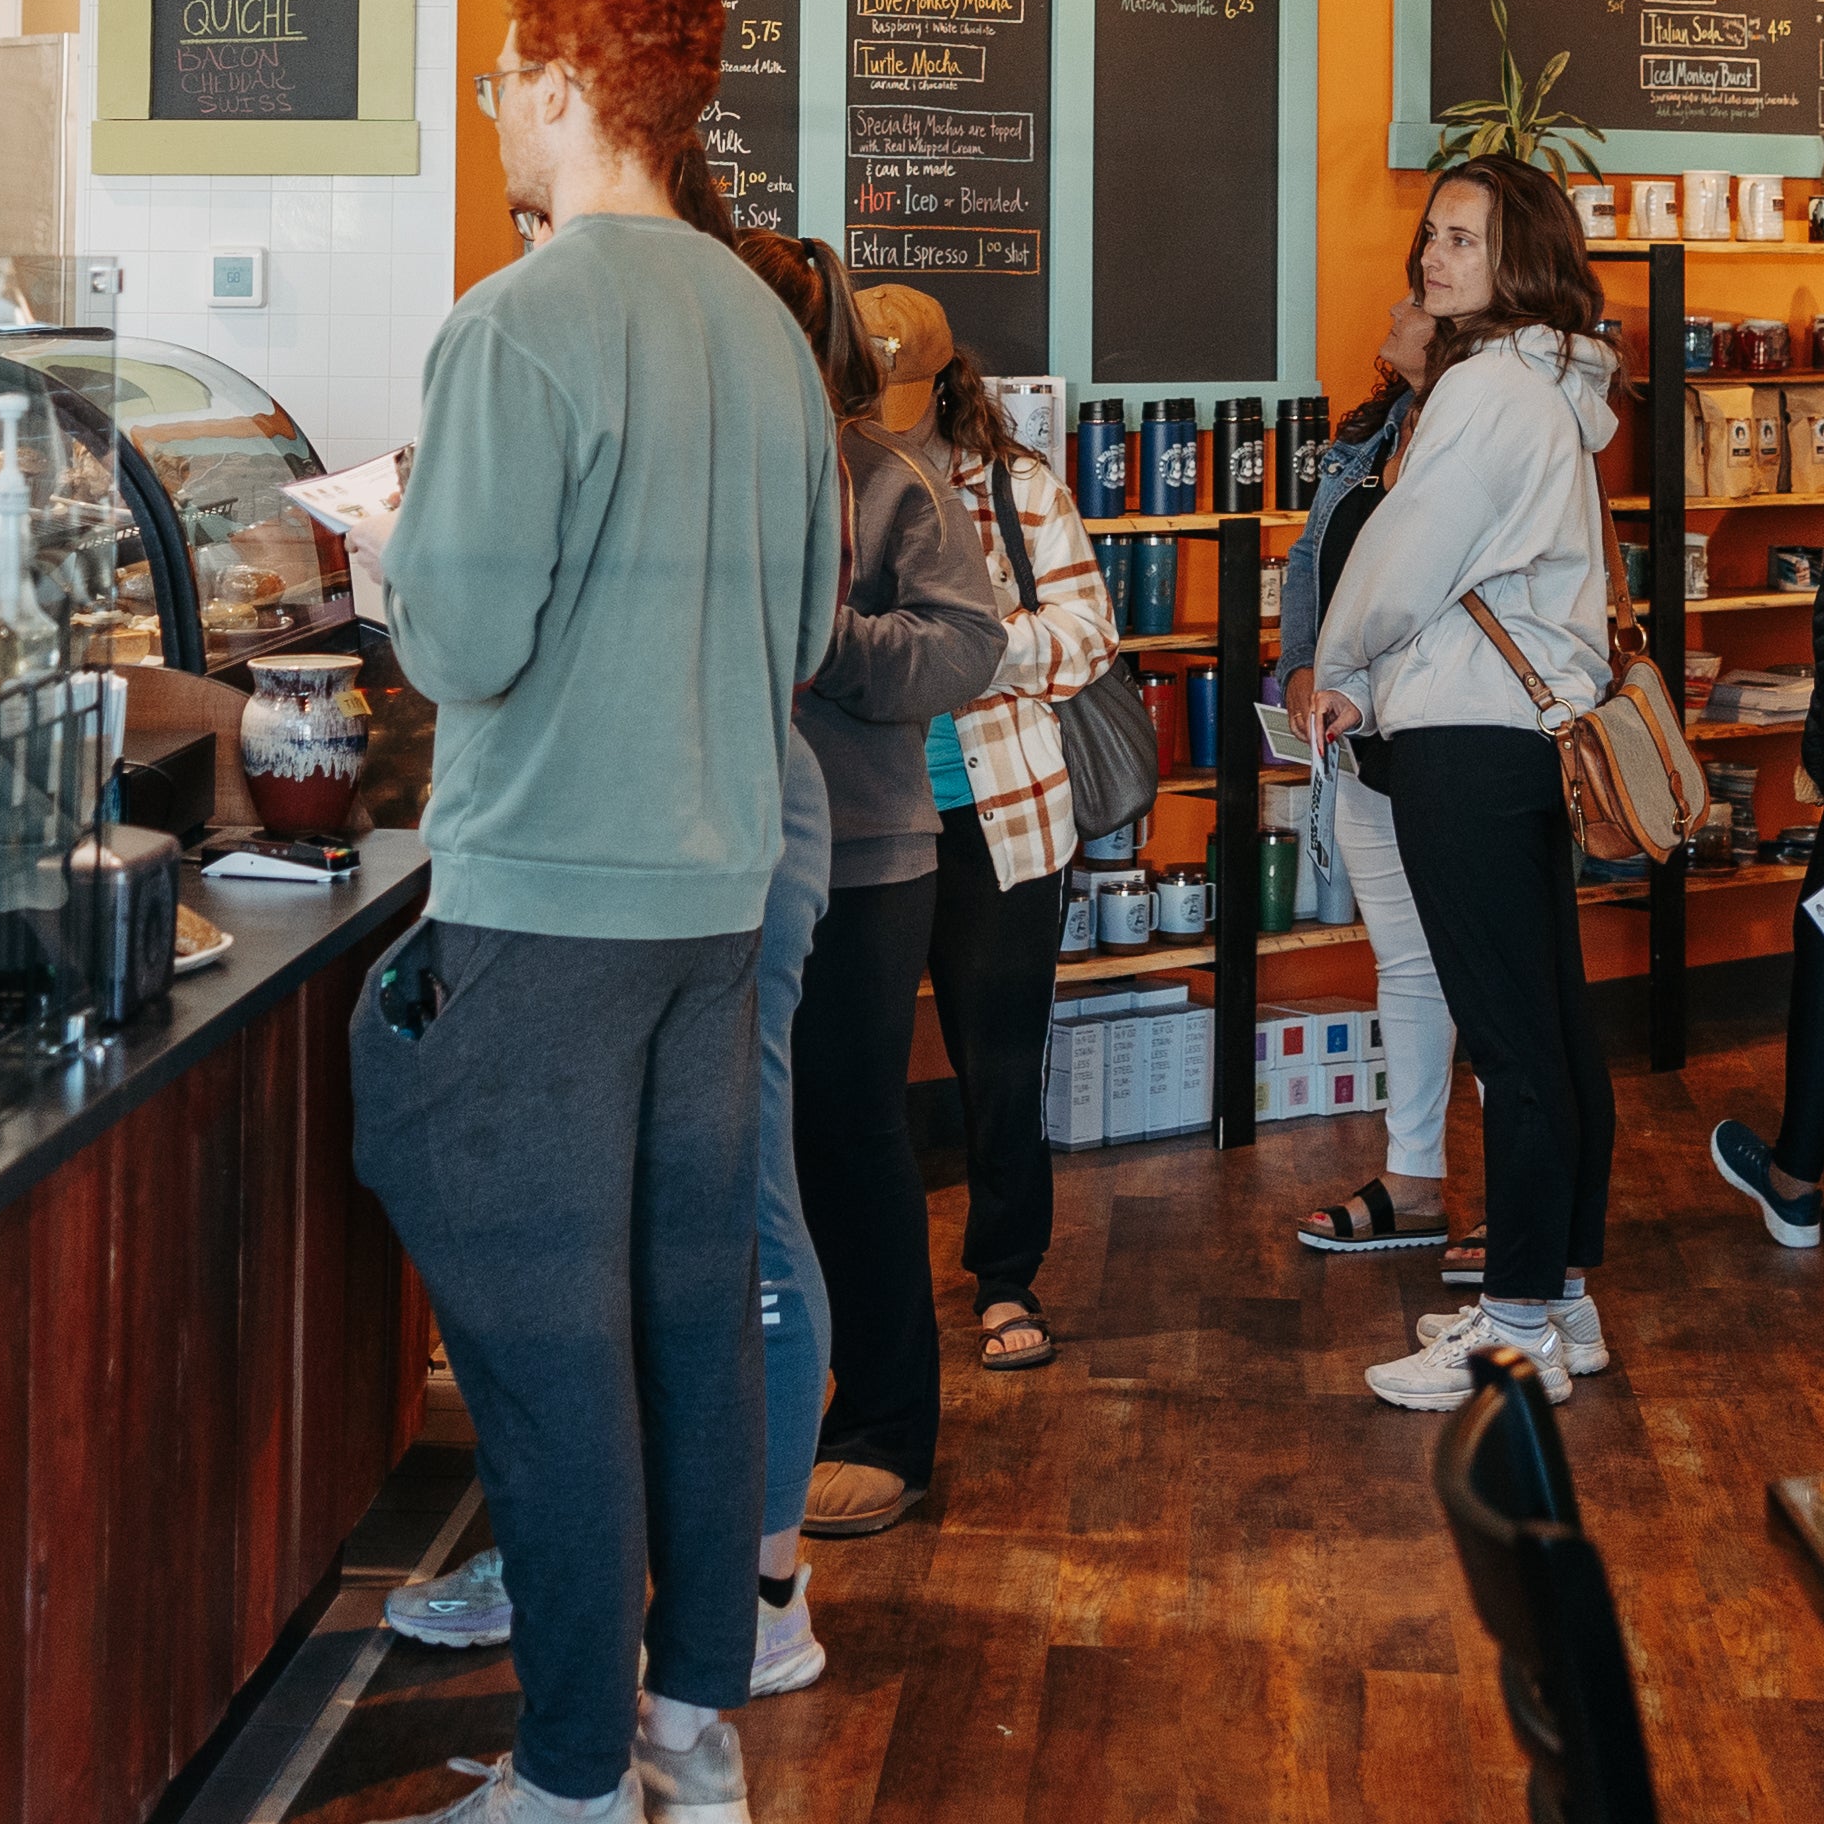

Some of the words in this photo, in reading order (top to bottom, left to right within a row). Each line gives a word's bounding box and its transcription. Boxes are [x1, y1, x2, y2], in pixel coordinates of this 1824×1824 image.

[741, 20, 782, 50] 5.75
[1648, 14, 1689, 45] Italian
[1692, 16, 1725, 44] Soda
[177, 42, 280, 72] BACON
[859, 46, 908, 76] Turtle
[911, 48, 963, 78] Mocha
[180, 69, 296, 95] CHEDDAR
[197, 93, 293, 114] SWISS
[850, 231, 899, 268] Extra
[904, 234, 968, 269] Espresso
